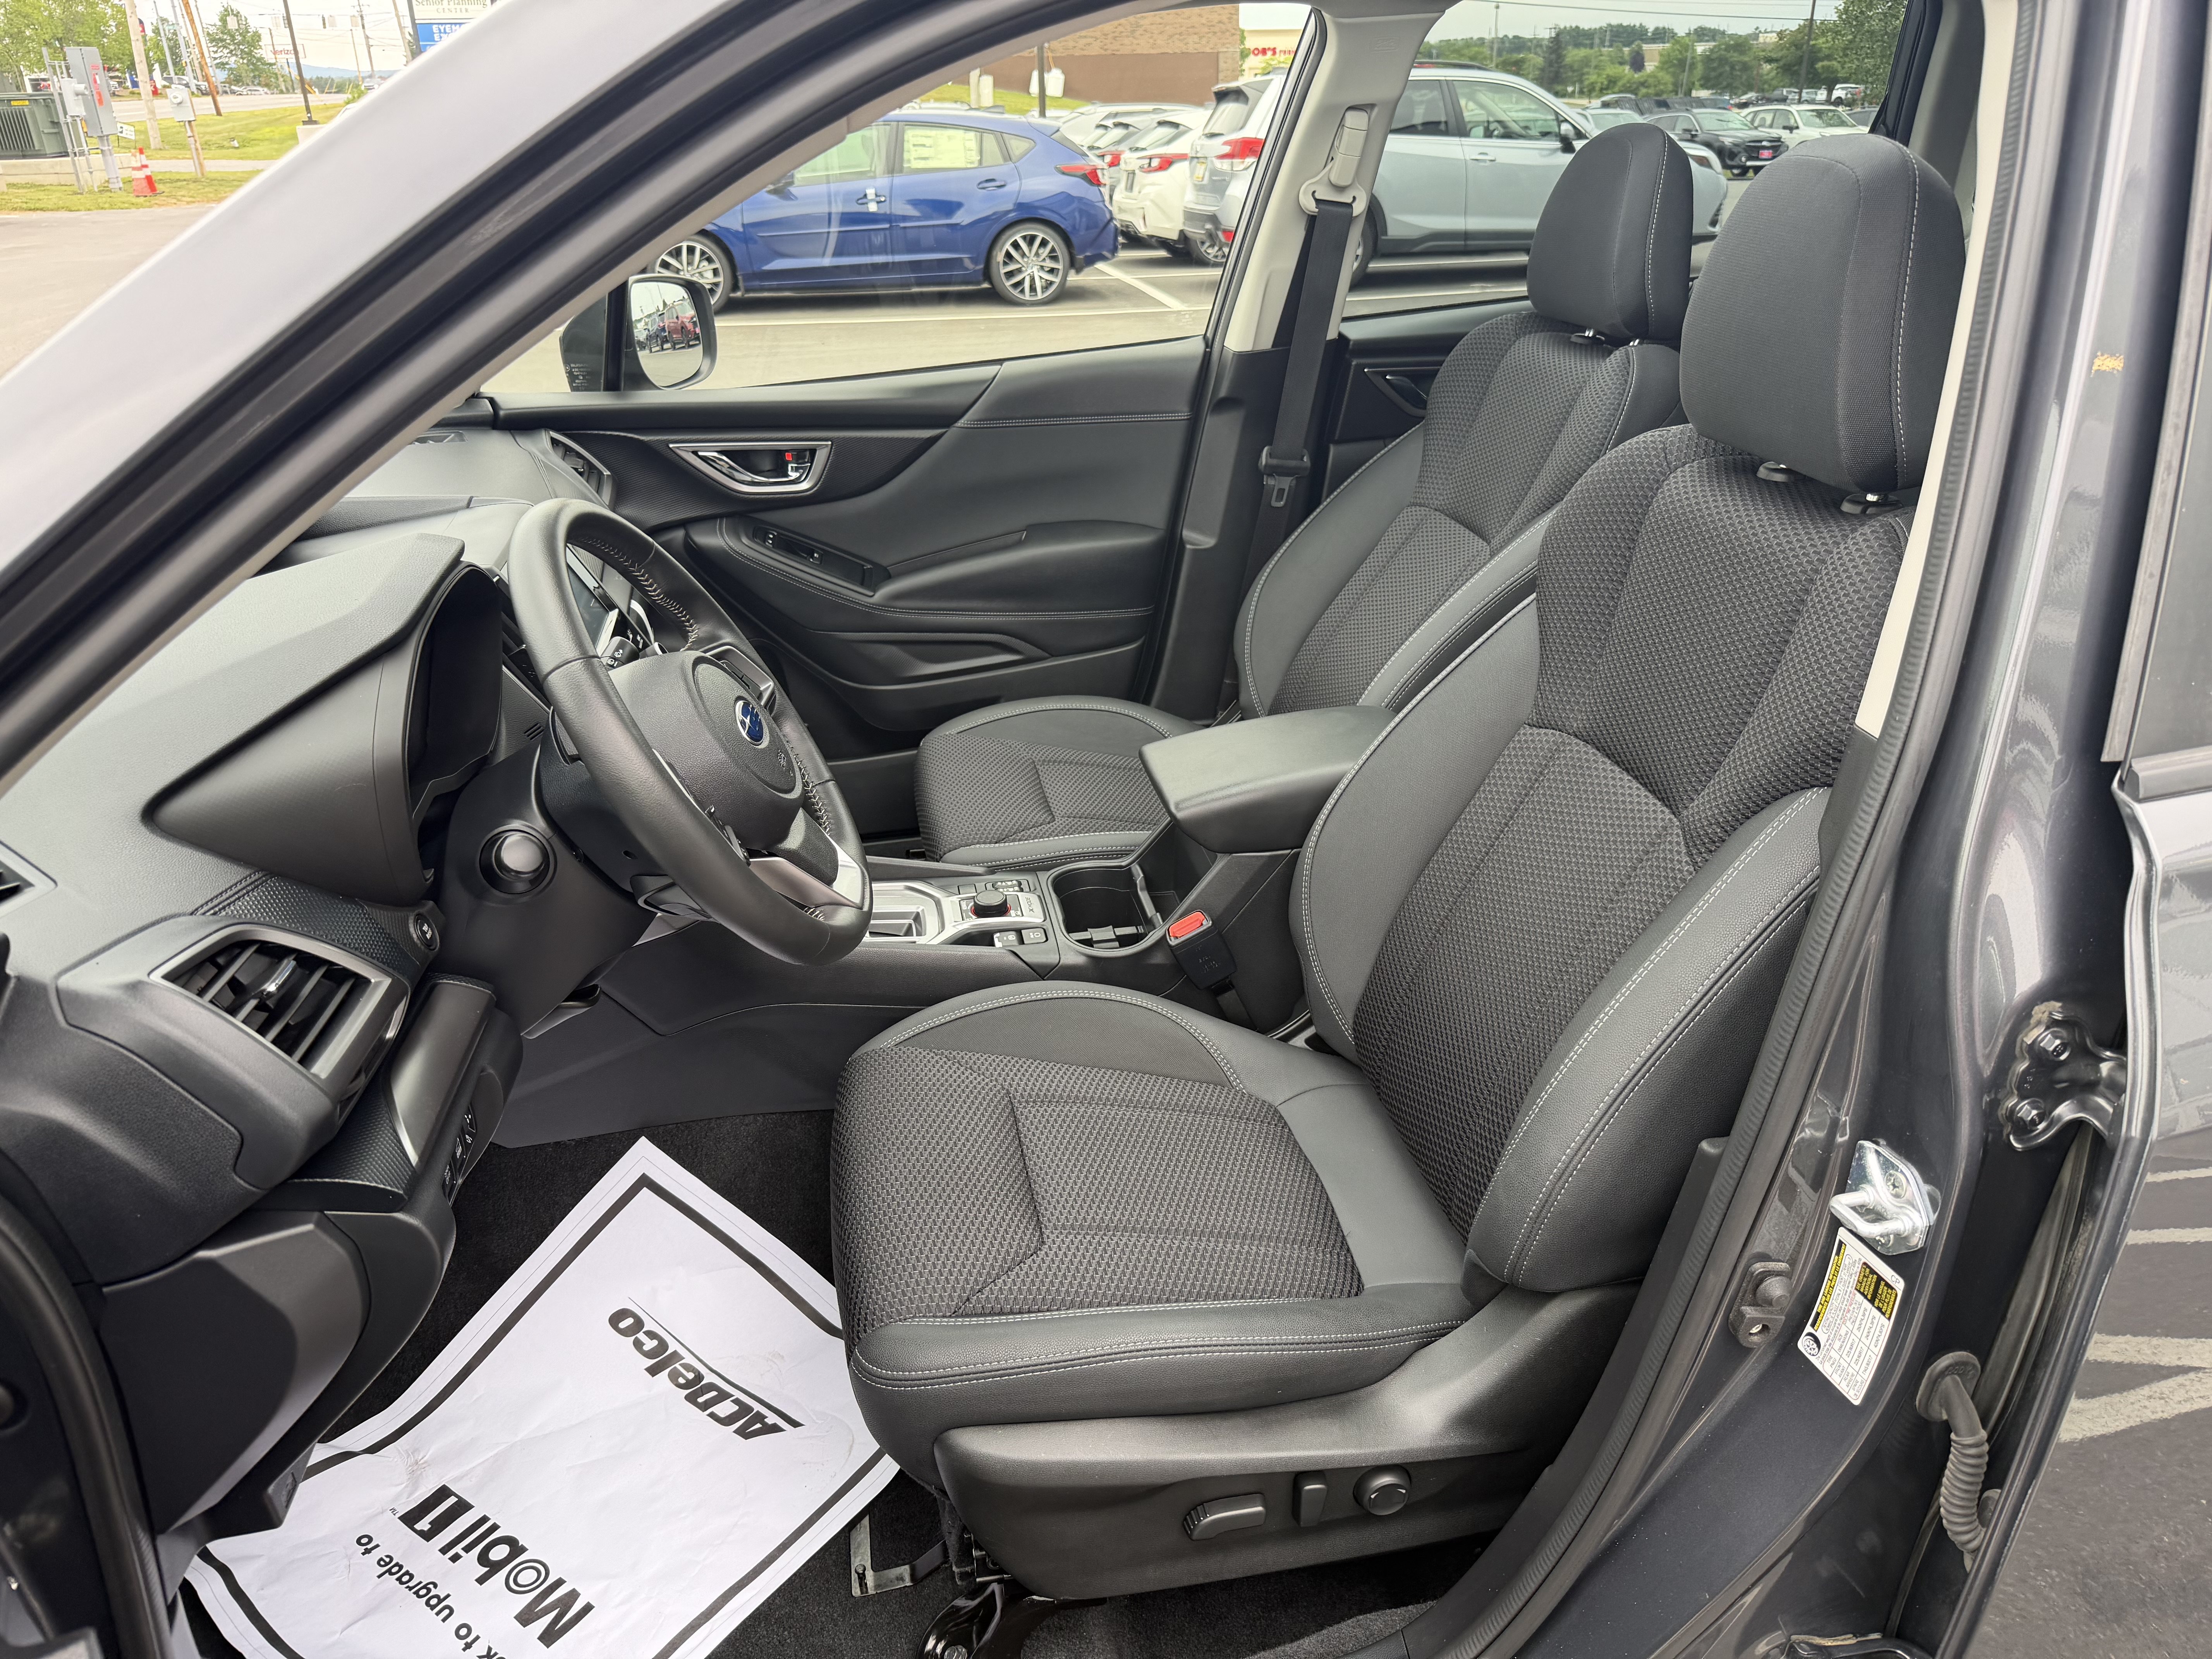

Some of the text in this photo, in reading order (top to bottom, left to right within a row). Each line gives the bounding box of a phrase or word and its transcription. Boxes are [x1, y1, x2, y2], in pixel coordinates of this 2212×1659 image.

[433, 24, 463, 33] EYEM
[1891, 1275, 1900, 1284] CP
[608, 1307, 787, 1440] ACDelco
[356, 1534, 381, 1556] to
[376, 1554, 455, 1624] upgrade
[438, 1514, 595, 1649] Mobil
[454, 1623, 481, 1652] to
